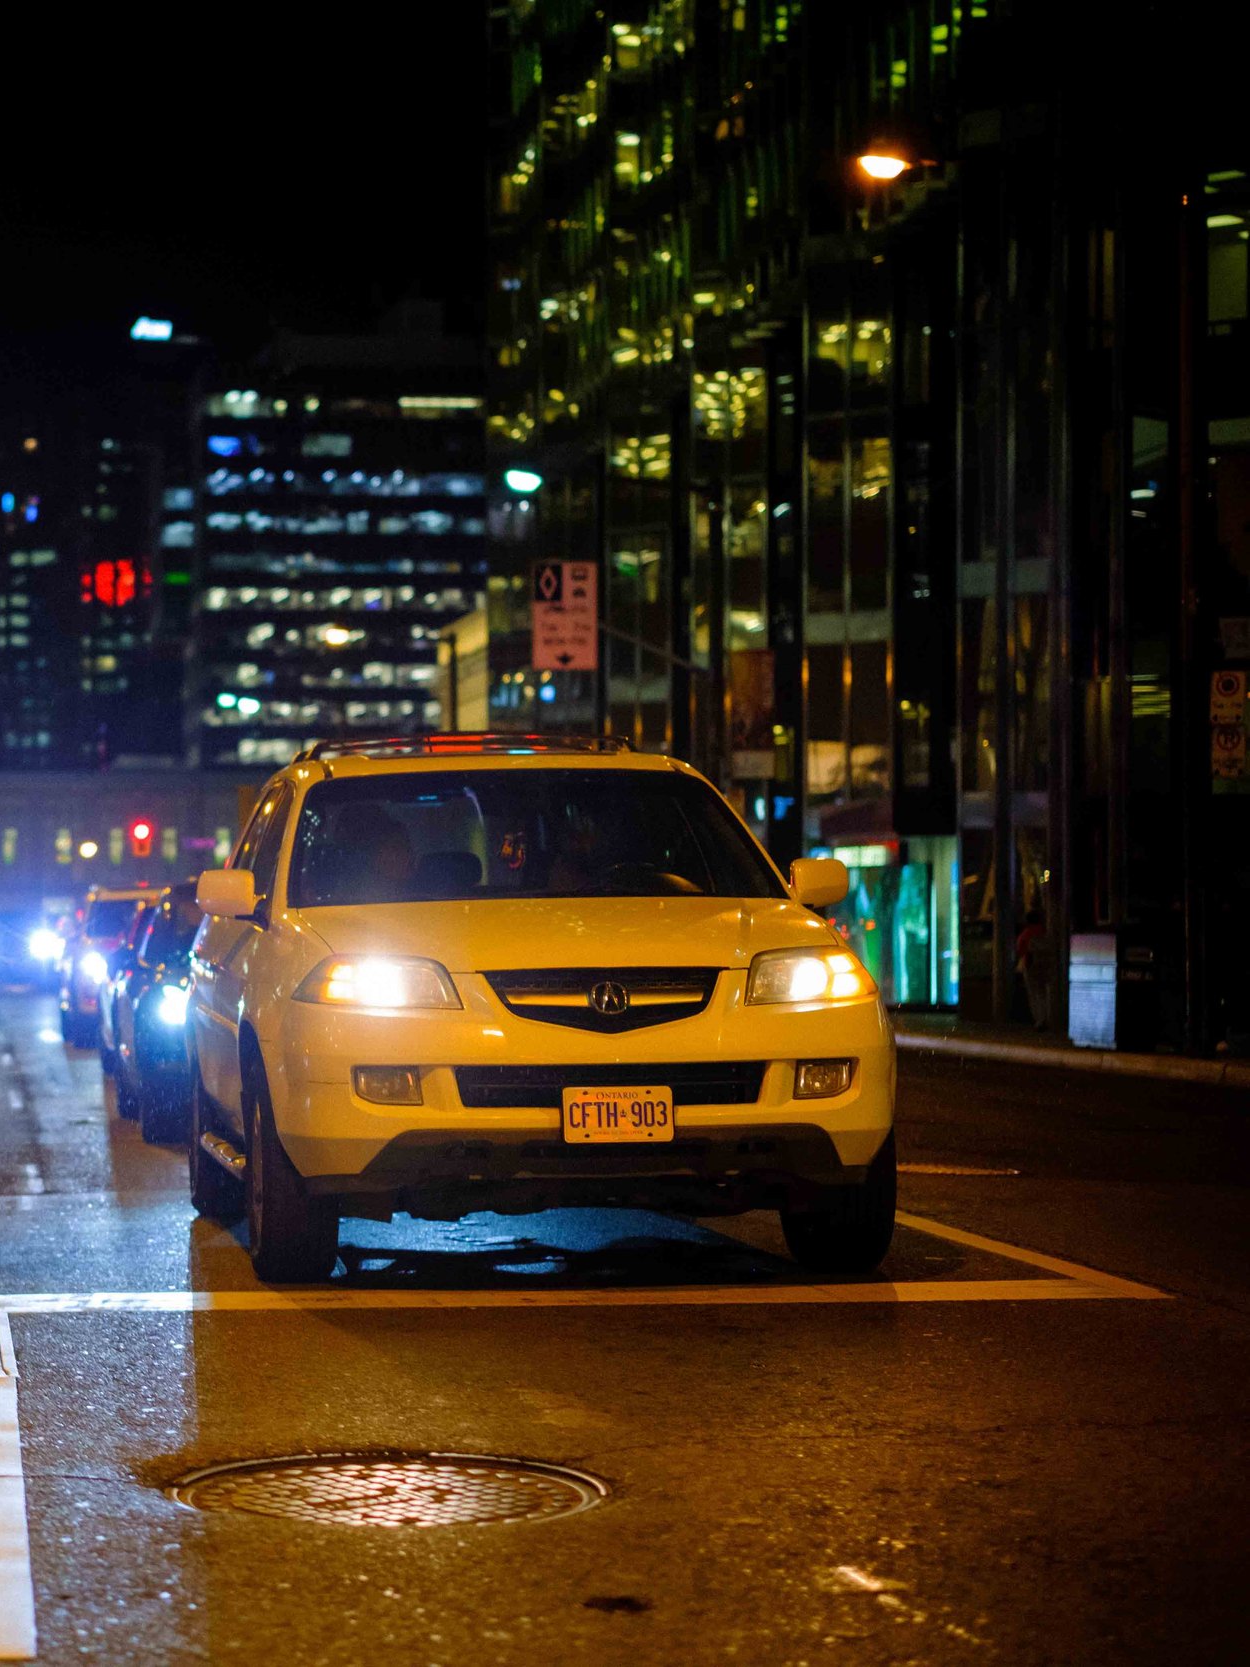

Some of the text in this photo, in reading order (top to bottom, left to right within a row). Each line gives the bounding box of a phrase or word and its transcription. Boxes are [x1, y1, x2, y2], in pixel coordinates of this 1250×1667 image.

[595, 1092, 639, 1101] ONTARIO
[569, 1101, 668, 1128] CFTH 903
